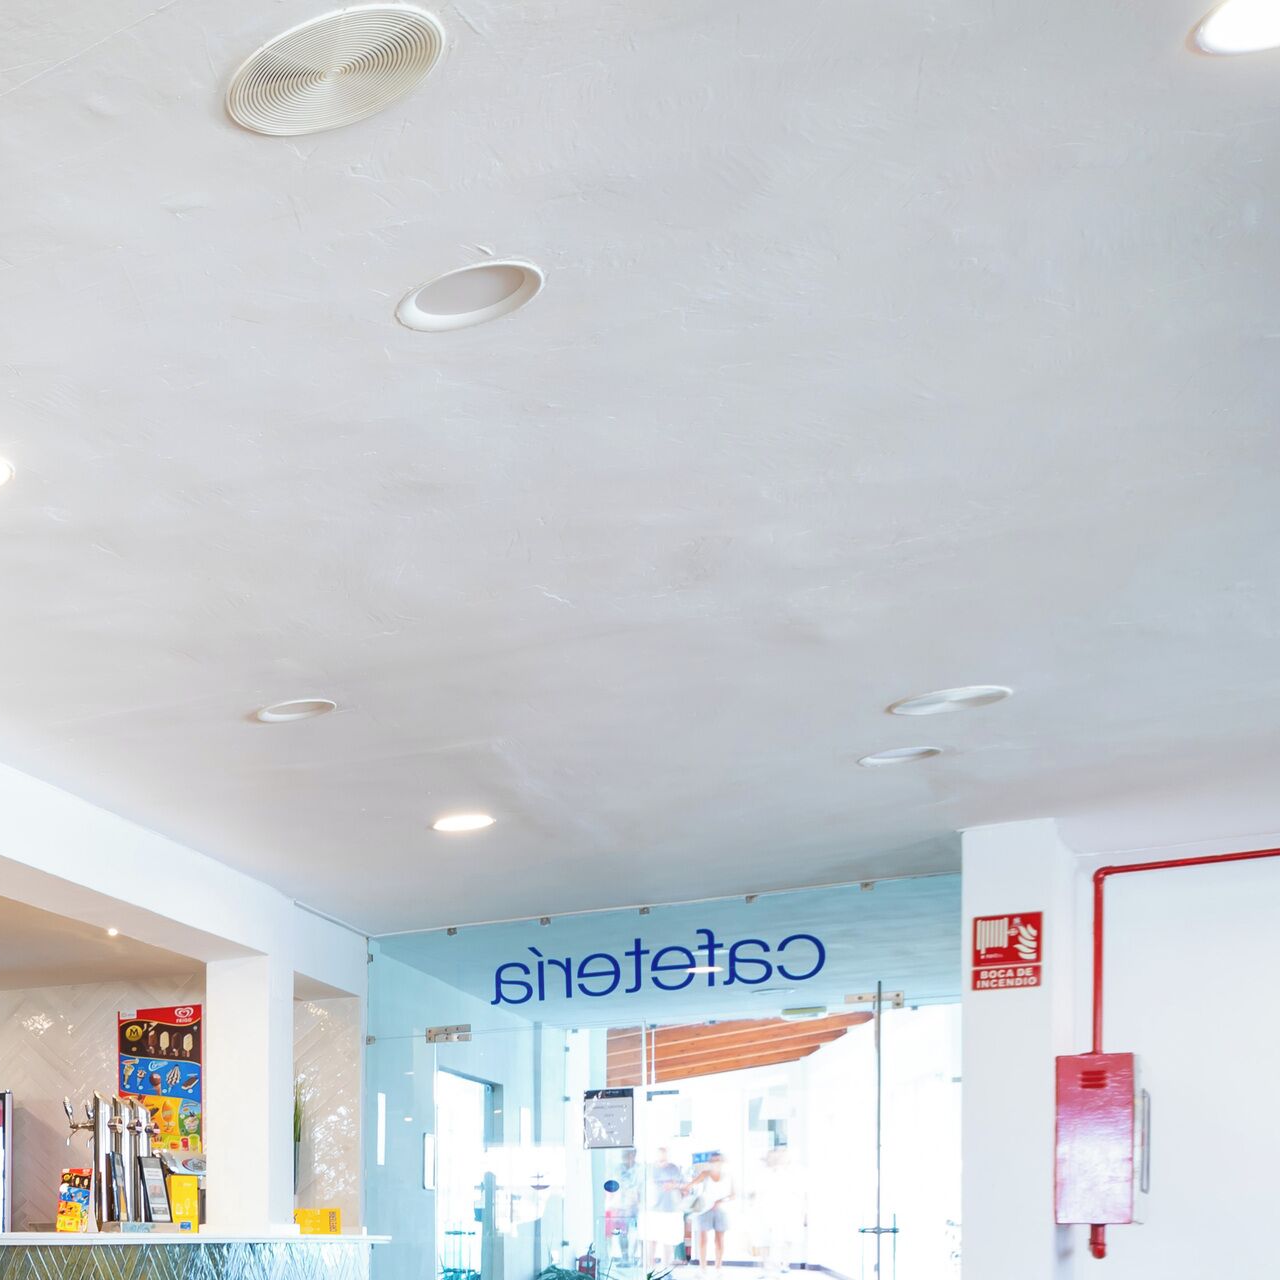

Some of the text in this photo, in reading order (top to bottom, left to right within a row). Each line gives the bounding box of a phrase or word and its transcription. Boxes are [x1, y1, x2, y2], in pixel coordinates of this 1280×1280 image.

[980, 967, 1034, 979] BOCA DE
[976, 976, 1038, 989] INCENDIO
